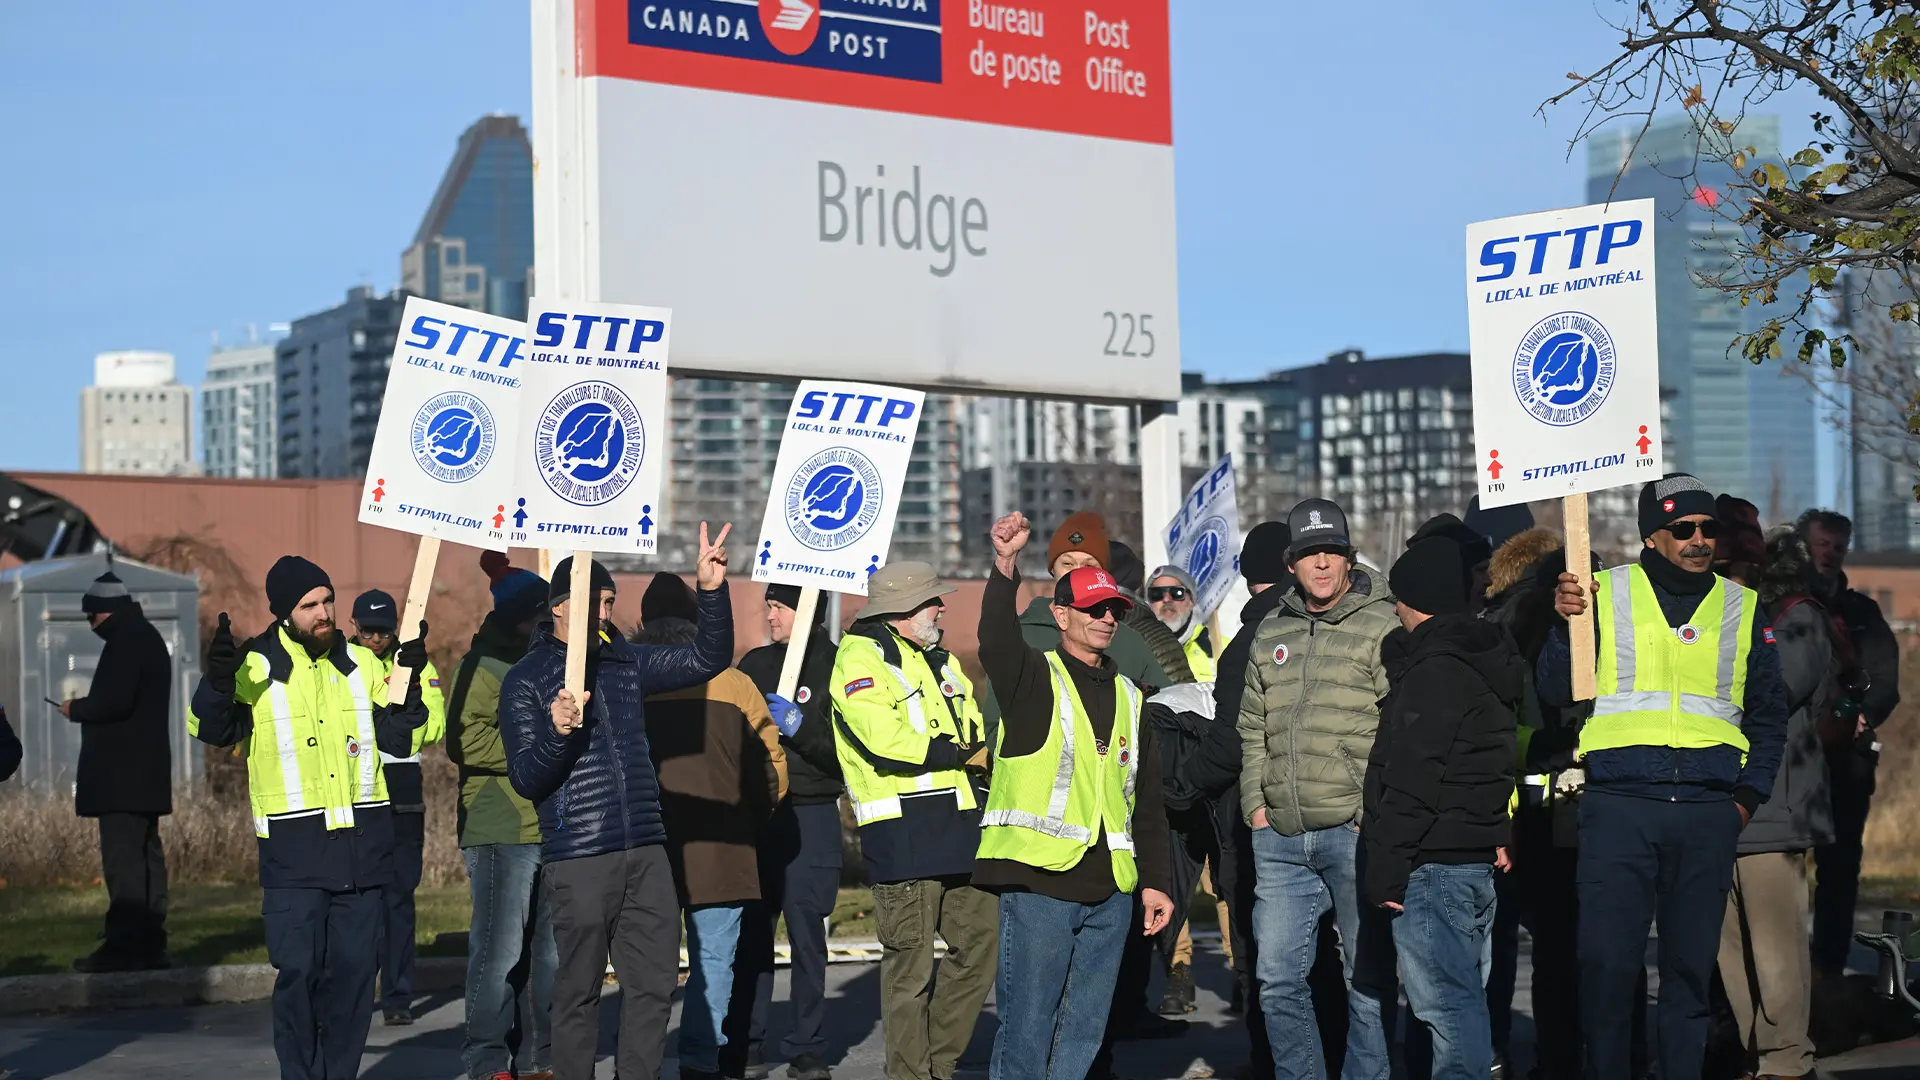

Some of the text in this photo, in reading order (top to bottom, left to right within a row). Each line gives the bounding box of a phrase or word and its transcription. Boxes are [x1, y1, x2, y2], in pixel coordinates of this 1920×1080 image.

[643, 6, 888, 59] CANADA POST
[968, 0, 1045, 37] Bureau
[1085, 11, 1130, 49] Post
[969, 39, 1062, 89] de poste
[1086, 56, 1146, 97] Office
[818, 160, 988, 277] Bridge
[1476, 219, 1643, 283] STTP
[1485, 269, 1644, 303] LOCAL DE MONTRÉAL
[404, 316, 526, 369] STTP
[533, 312, 665, 353] STTP
[1102, 310, 1155, 358] 225
[407, 355, 521, 389] LOCAL DE MONTRÉ
[531, 352, 660, 370] LOCAL DE MONTRÉAL
[1516, 316, 1613, 402] SYNDICAT DES TRAVAILLEURS ET TRAVAILLEUSES DES POSTES
[796, 391, 915, 427] STTP
[1531, 399, 1553, 421] SECTION
[1552, 408, 1571, 423] LOCALE
[1571, 407, 1579, 421] DE
[538, 384, 641, 471] SYNDICAT DES TRAVAILLEURS ET TRAVAILLEUSES DES POSTES
[791, 422, 907, 443] LOCAL DE MONTRÉAL
[838, 450, 846, 462] ET
[1522, 453, 1626, 481] STTPMTL.COM
[1636, 457, 1654, 468] FTQ
[549, 470, 573, 496] SECTION
[570, 482, 592, 502] LOCALE
[592, 485, 600, 501] DE
[1488, 482, 1505, 493] FTQ
[398, 503, 482, 529] STTPMTL.COM
[1169, 462, 1228, 551] STTP
[510, 532, 527, 542] FTQ
[537, 522, 628, 536] STTPMTL.COM
[636, 538, 653, 548] FTQ
[776, 561, 856, 580] STTPMTL.COM
